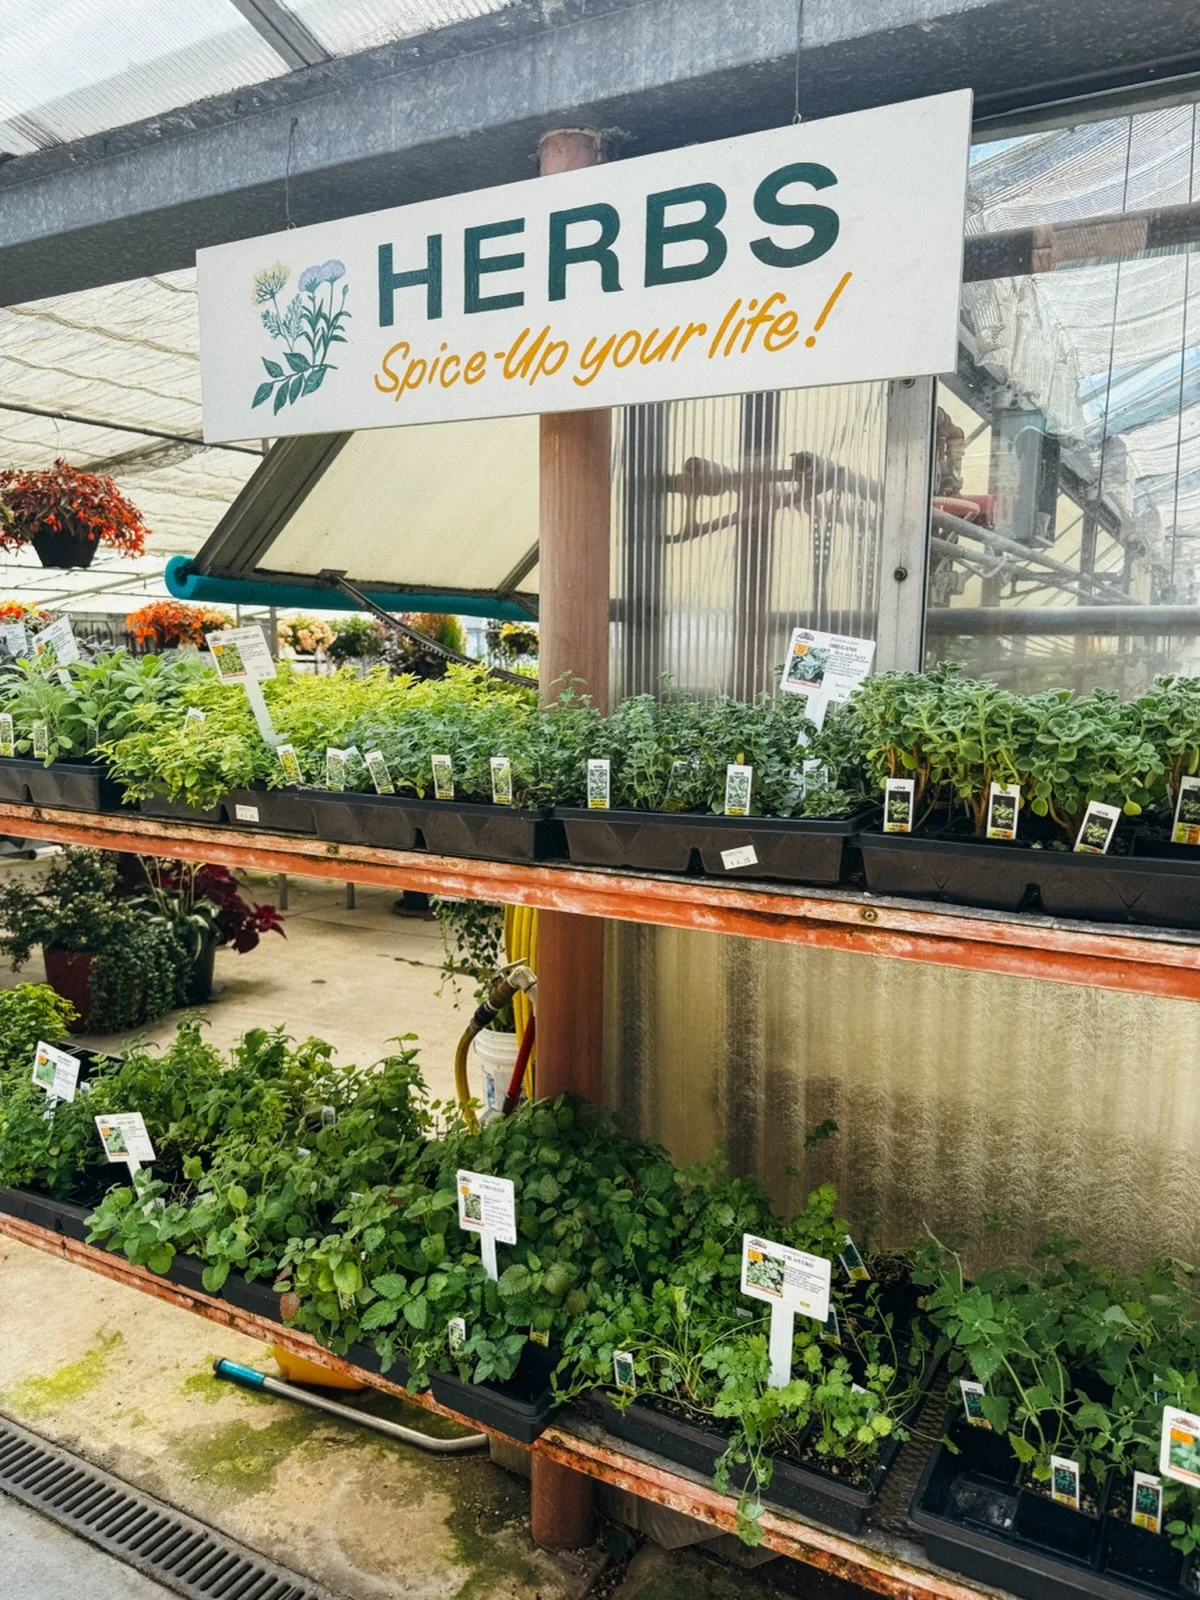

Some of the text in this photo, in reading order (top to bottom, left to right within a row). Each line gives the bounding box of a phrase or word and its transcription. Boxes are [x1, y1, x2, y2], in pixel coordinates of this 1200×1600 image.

[378, 161, 841, 327] HERBS
[373, 270, 853, 401] Spice-Up your life!
